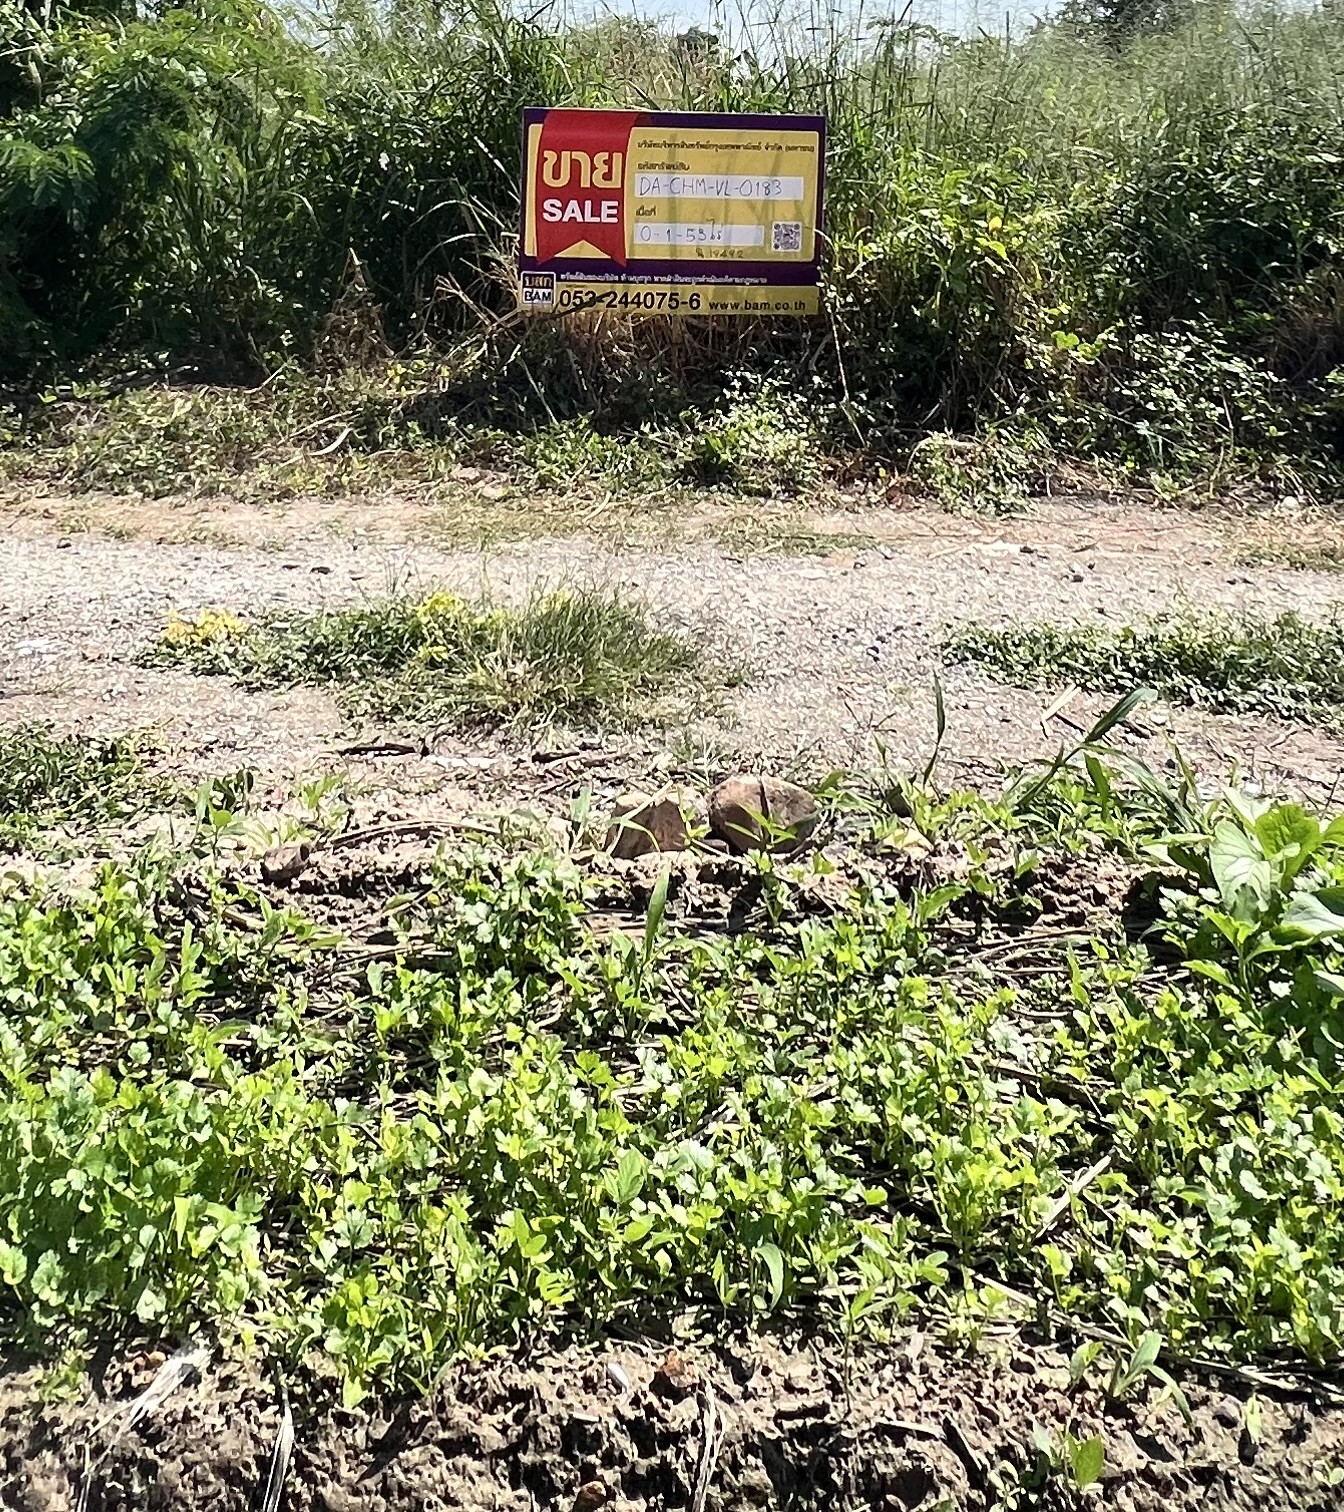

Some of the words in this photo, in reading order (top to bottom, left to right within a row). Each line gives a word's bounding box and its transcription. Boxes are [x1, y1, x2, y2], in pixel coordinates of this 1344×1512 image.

[543, 150, 623, 189] ขาย
[639, 176, 782, 197] DA-CHM-VL-0183
[543, 199, 618, 223] SALE
[524, 290, 552, 302] BAM
[708, 299, 806, 311] www.bam.co.th
